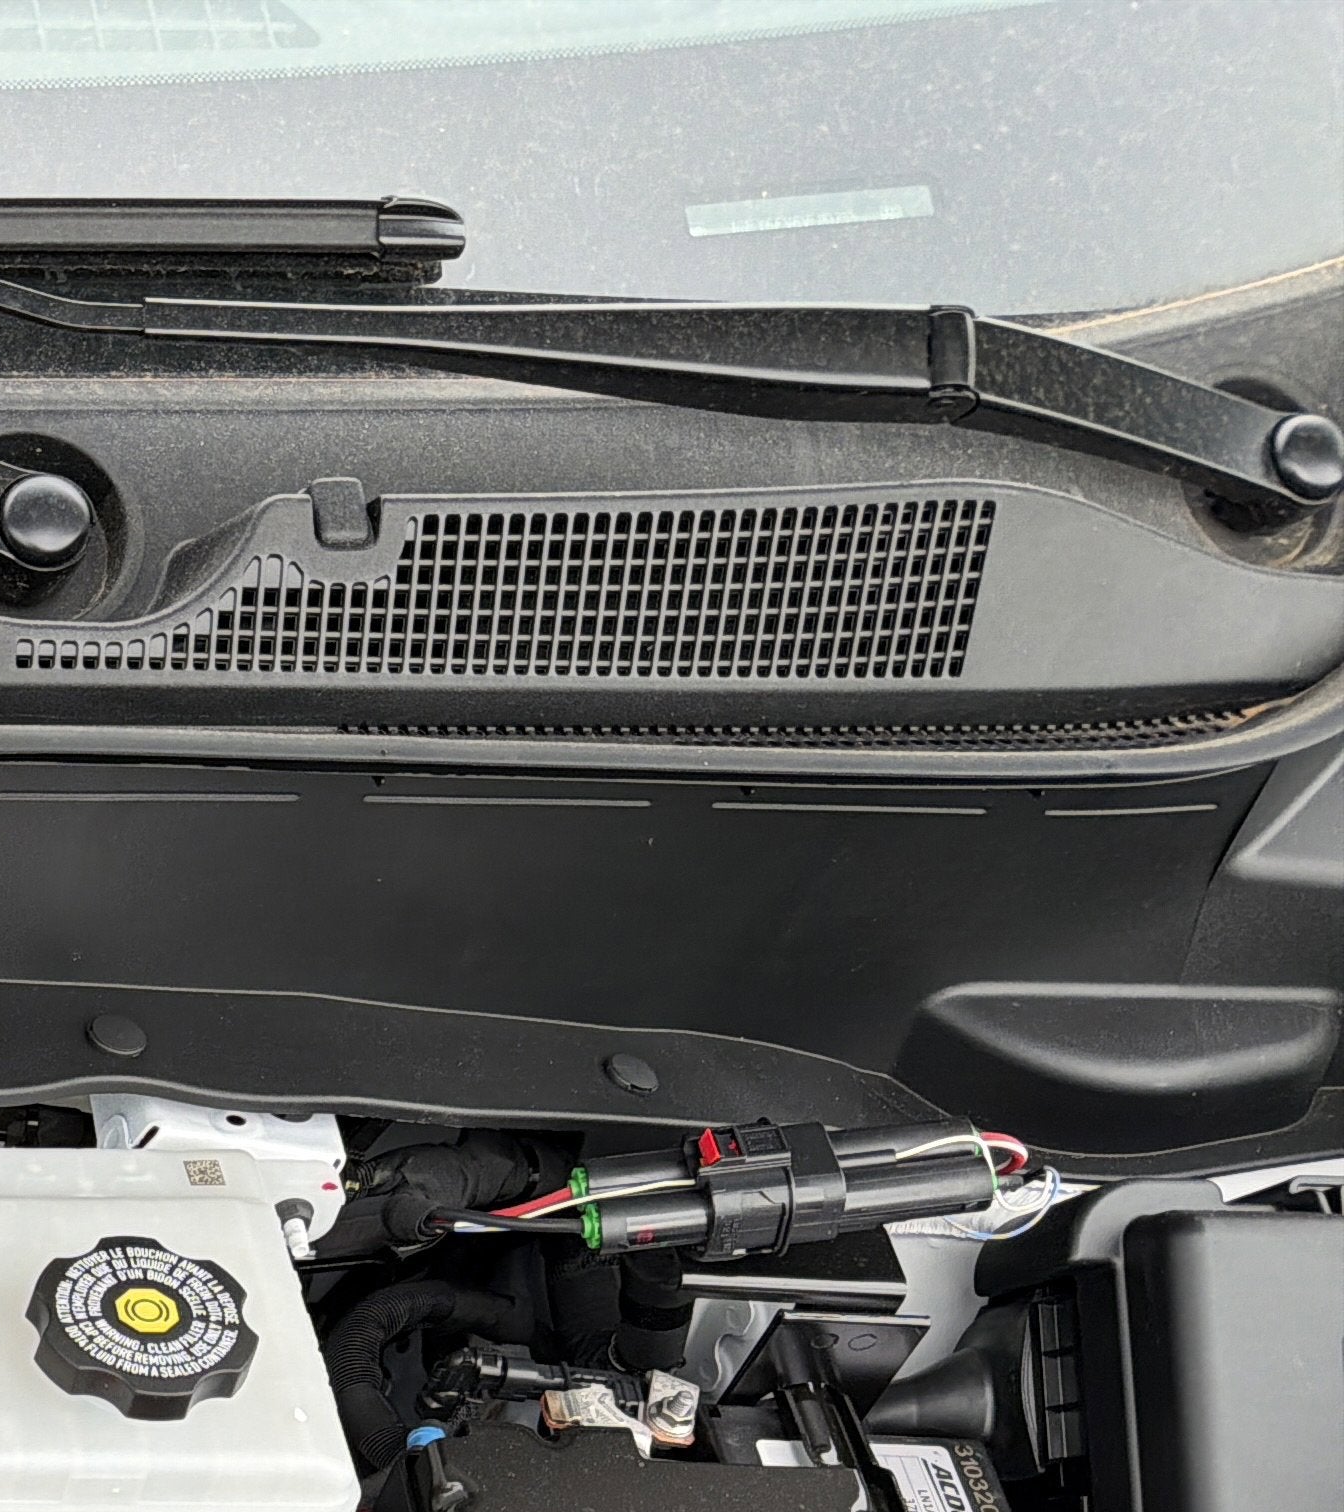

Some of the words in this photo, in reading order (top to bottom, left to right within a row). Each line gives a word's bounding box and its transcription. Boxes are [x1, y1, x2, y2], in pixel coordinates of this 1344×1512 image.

[109, 1247, 124, 1260] LE
[125, 1246, 179, 1265] BOUCHON
[111, 1258, 129, 1270] DU
[130, 1257, 172, 1273] LIQUIDE
[146, 1269, 182, 1290] BIDON
[79, 1320, 99, 1339] CAP
[93, 1334, 135, 1361] BEFORE
[146, 1338, 185, 1355] CLEAN
[84, 1343, 119, 1366] FLUID
[115, 1358, 150, 1377] FROM
[150, 1364, 161, 1378] A
[160, 1361, 203, 1378] SEALED
